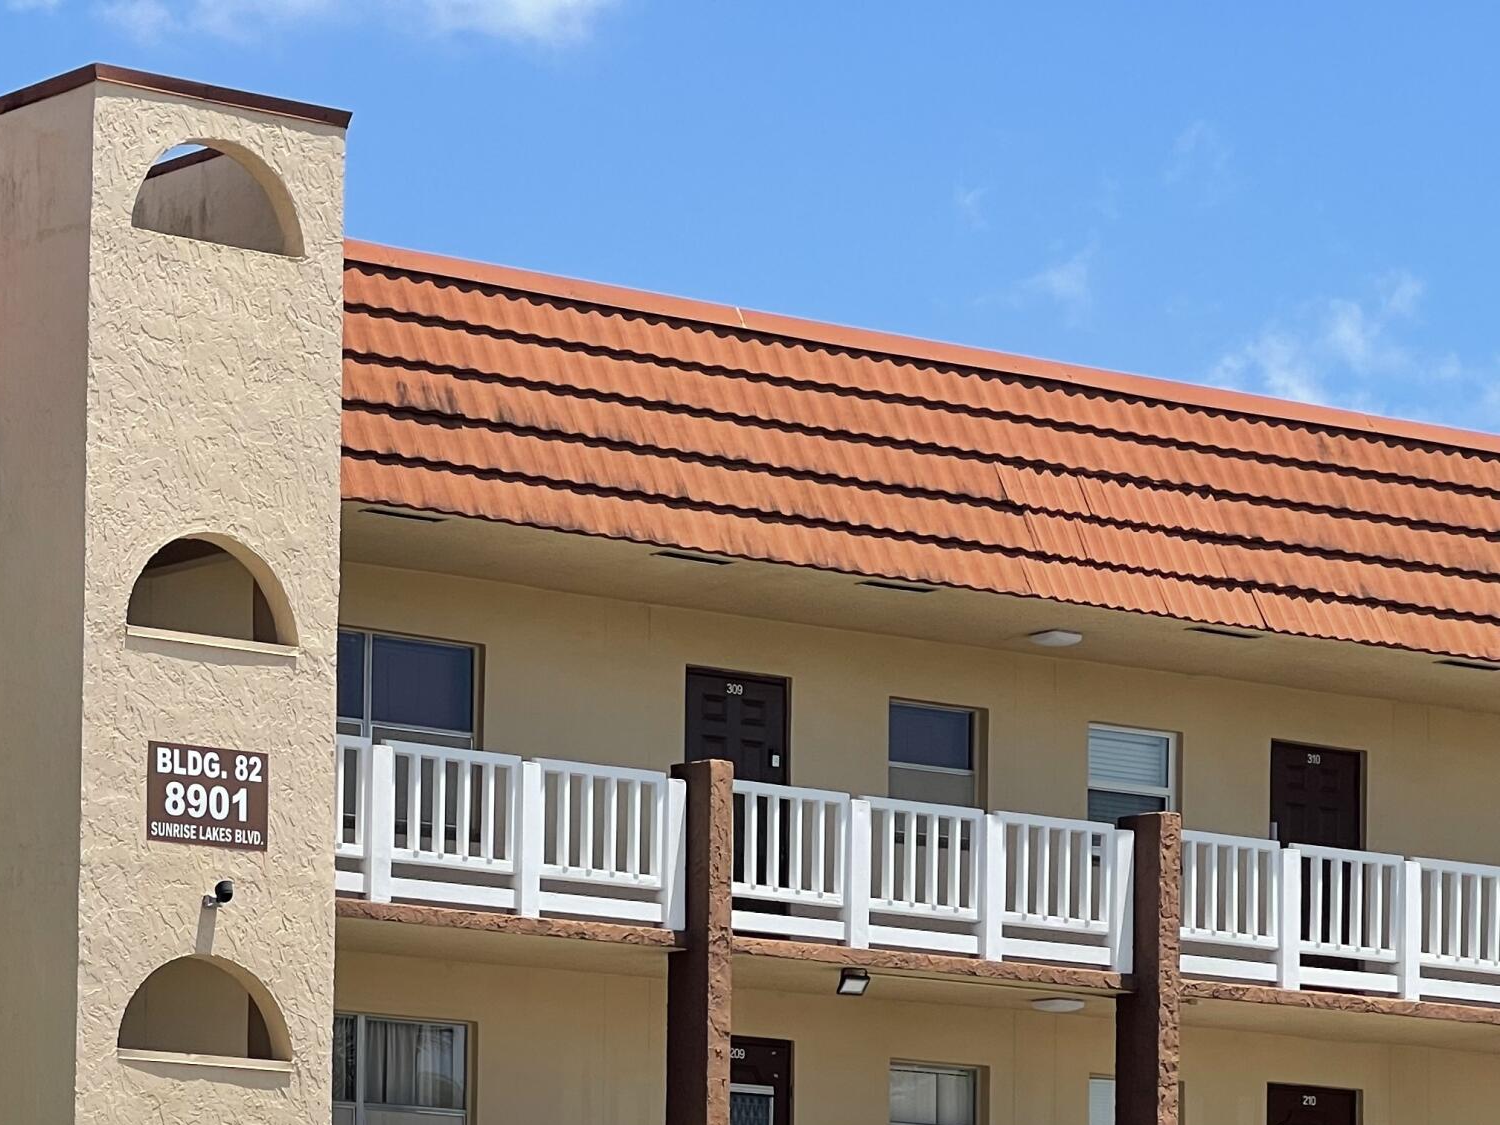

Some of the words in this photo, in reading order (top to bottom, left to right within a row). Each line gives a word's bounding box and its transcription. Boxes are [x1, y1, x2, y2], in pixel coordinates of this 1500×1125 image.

[726, 683, 743, 695] 309
[156, 746, 227, 779] BLDG.
[234, 755, 262, 782] 82
[1307, 753, 1320, 764] 310
[165, 781, 247, 822] 8901
[151, 821, 197, 839] SUNRISE
[199, 826, 232, 842] LAKES
[234, 829, 264, 845] BLVD.
[1302, 1095, 1317, 1106] 210
